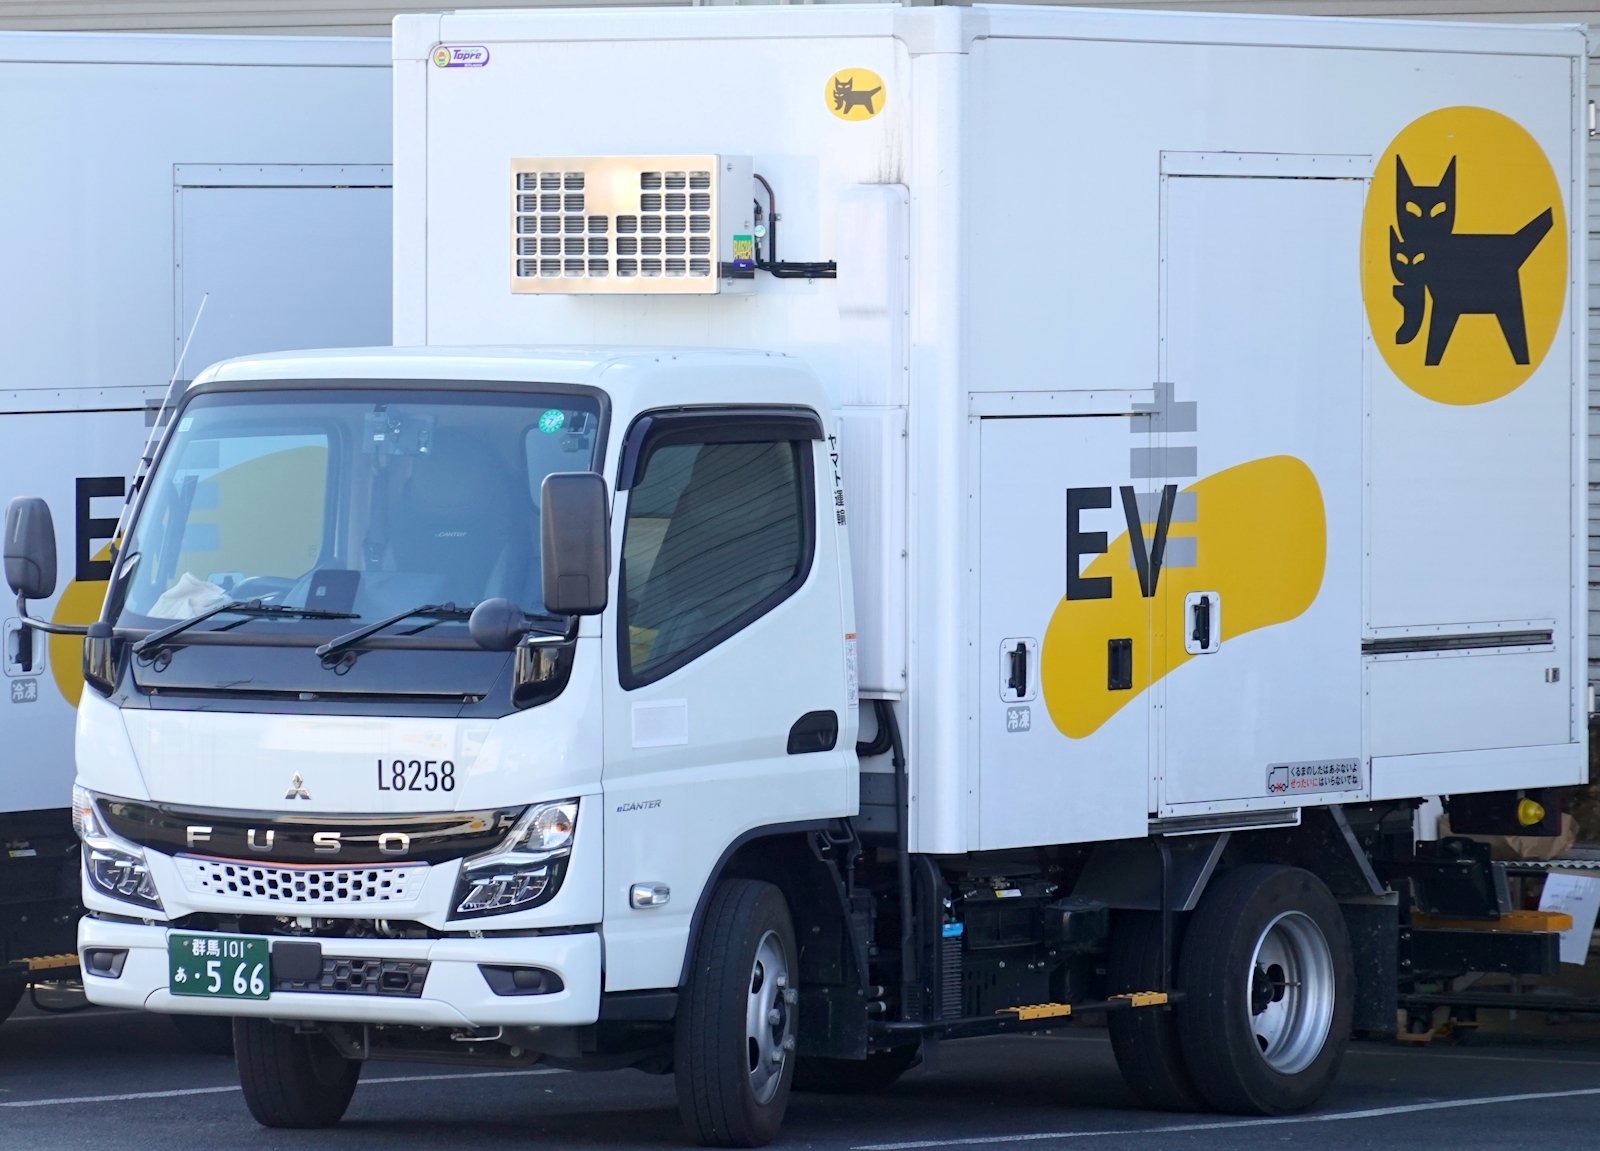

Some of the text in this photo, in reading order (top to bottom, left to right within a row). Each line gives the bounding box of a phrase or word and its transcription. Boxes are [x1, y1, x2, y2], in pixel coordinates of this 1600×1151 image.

[453, 49, 482, 61] Topre
[828, 433, 846, 526] ヤマト運輸
[1066, 484, 1178, 601] EV
[12, 681, 37, 701] 冷凍
[1007, 709, 1031, 730] 冷凍
[377, 759, 456, 792] L8258
[1290, 762, 1358, 777] くるまのしたはあぶないよ
[186, 825, 411, 856] FUSO
